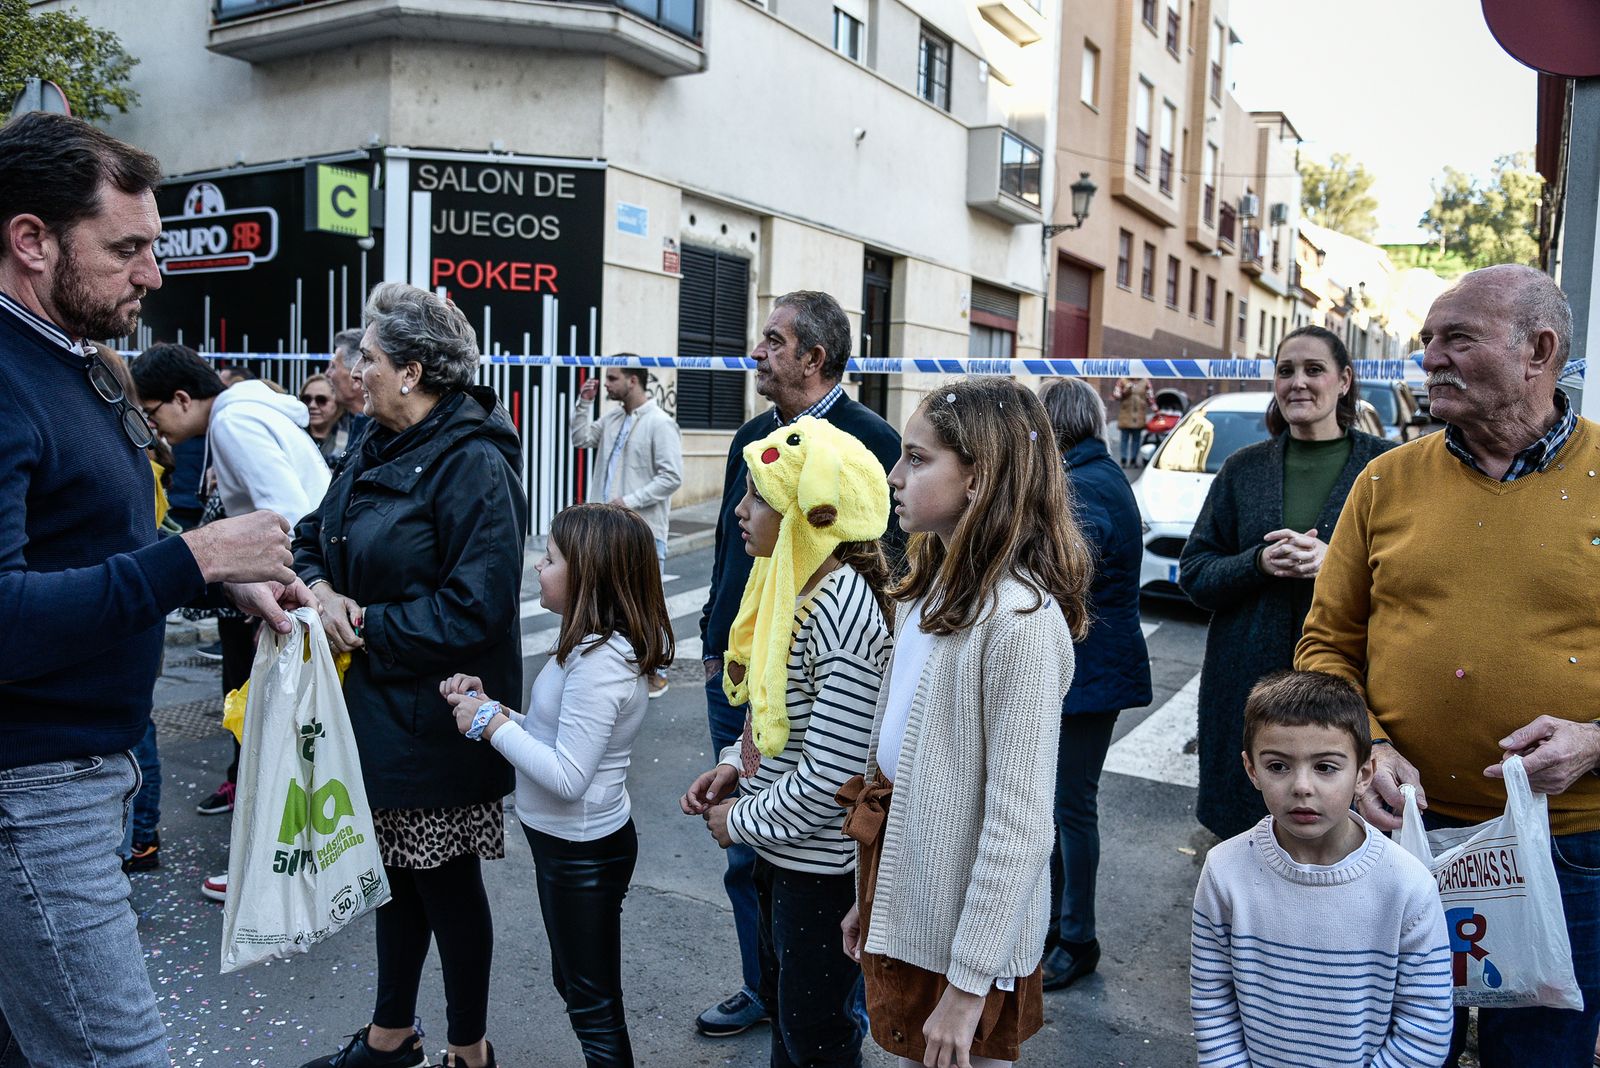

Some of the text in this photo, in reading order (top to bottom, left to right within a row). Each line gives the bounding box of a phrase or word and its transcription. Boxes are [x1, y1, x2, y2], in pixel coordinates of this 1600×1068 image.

[418, 164, 576, 198] SALON DE
[331, 184, 357, 218] C
[153, 225, 228, 258] GRUPO
[432, 209, 560, 241] JUEGOS
[432, 257, 558, 294] POKER
[1438, 850, 1500, 892] CARDENAS
